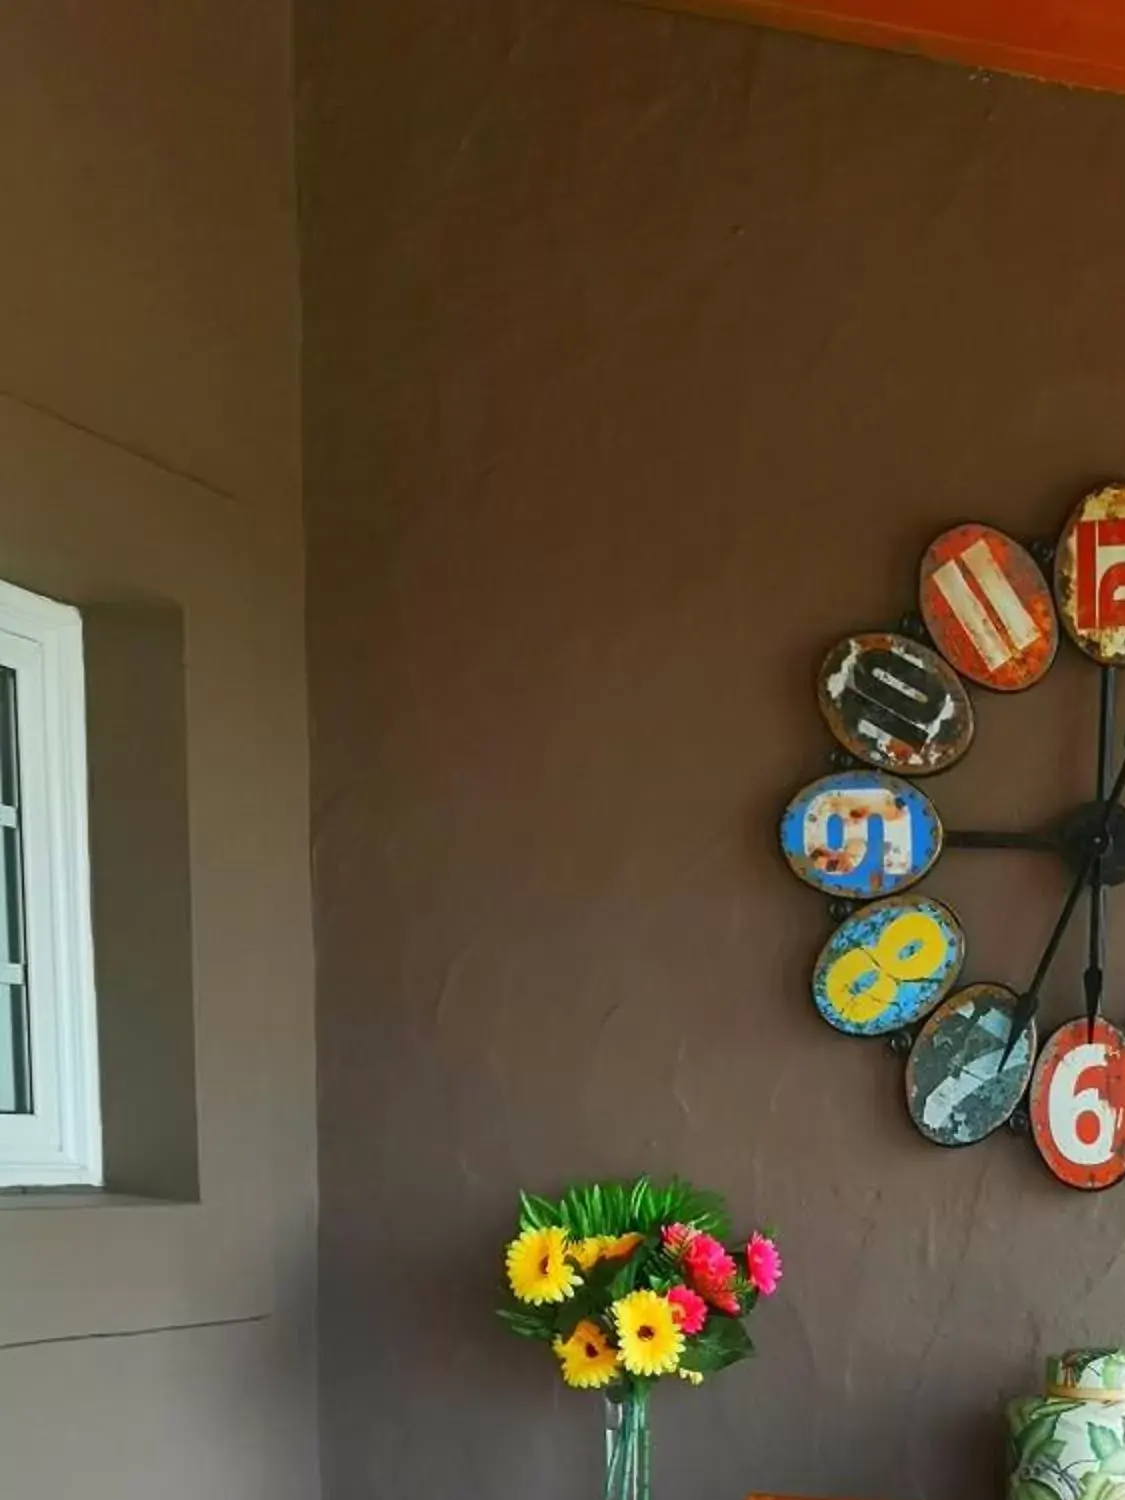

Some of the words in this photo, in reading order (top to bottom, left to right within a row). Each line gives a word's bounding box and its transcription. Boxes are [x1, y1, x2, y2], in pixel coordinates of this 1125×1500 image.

[842, 647, 948, 753] 10
[803, 788, 913, 876] 9
[826, 911, 947, 1023] 8
[1047, 1041, 1122, 1166] 6
